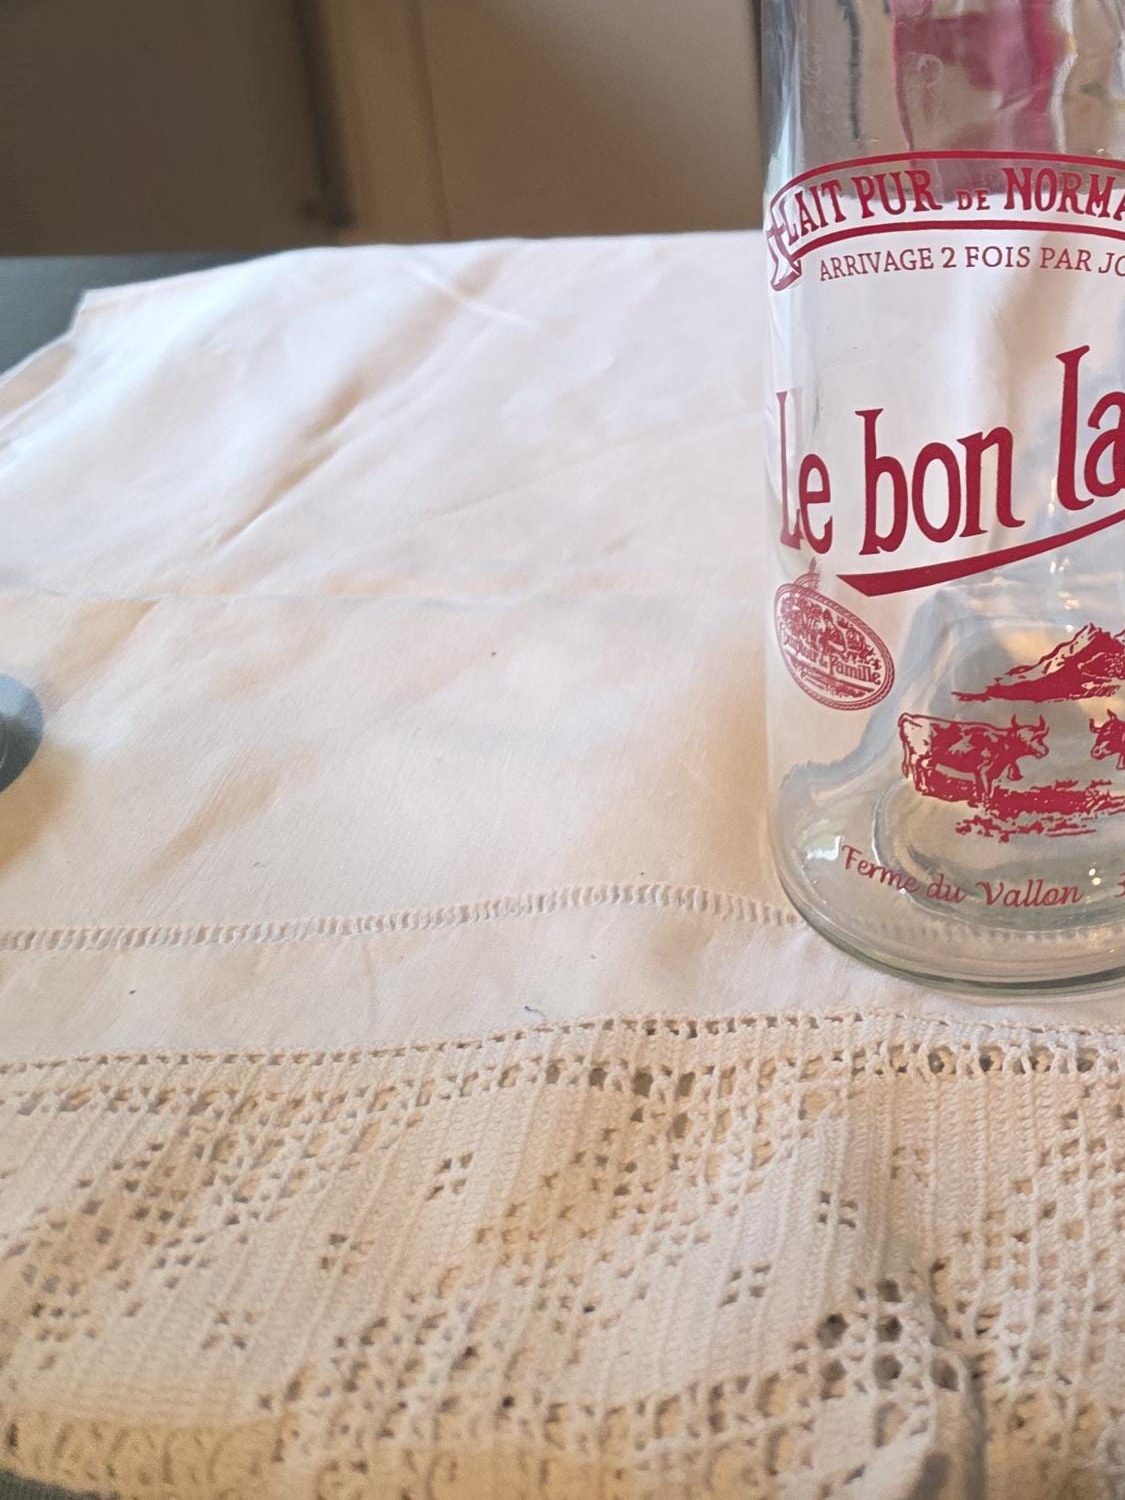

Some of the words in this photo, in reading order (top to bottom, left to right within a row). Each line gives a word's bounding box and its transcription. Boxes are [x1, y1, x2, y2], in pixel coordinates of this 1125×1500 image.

[780, 178, 847, 246] LAIT
[851, 170, 943, 219] PUR
[820, 248, 934, 282] ARRIVAGE
[942, 247, 957, 269] 2
[965, 246, 1031, 269] FOIS
[1039, 247, 1092, 272] PAR
[855, 408, 1026, 555] bon
[842, 844, 921, 893] Ferme
[926, 873, 966, 904] du
[975, 878, 1084, 908] Vallon
